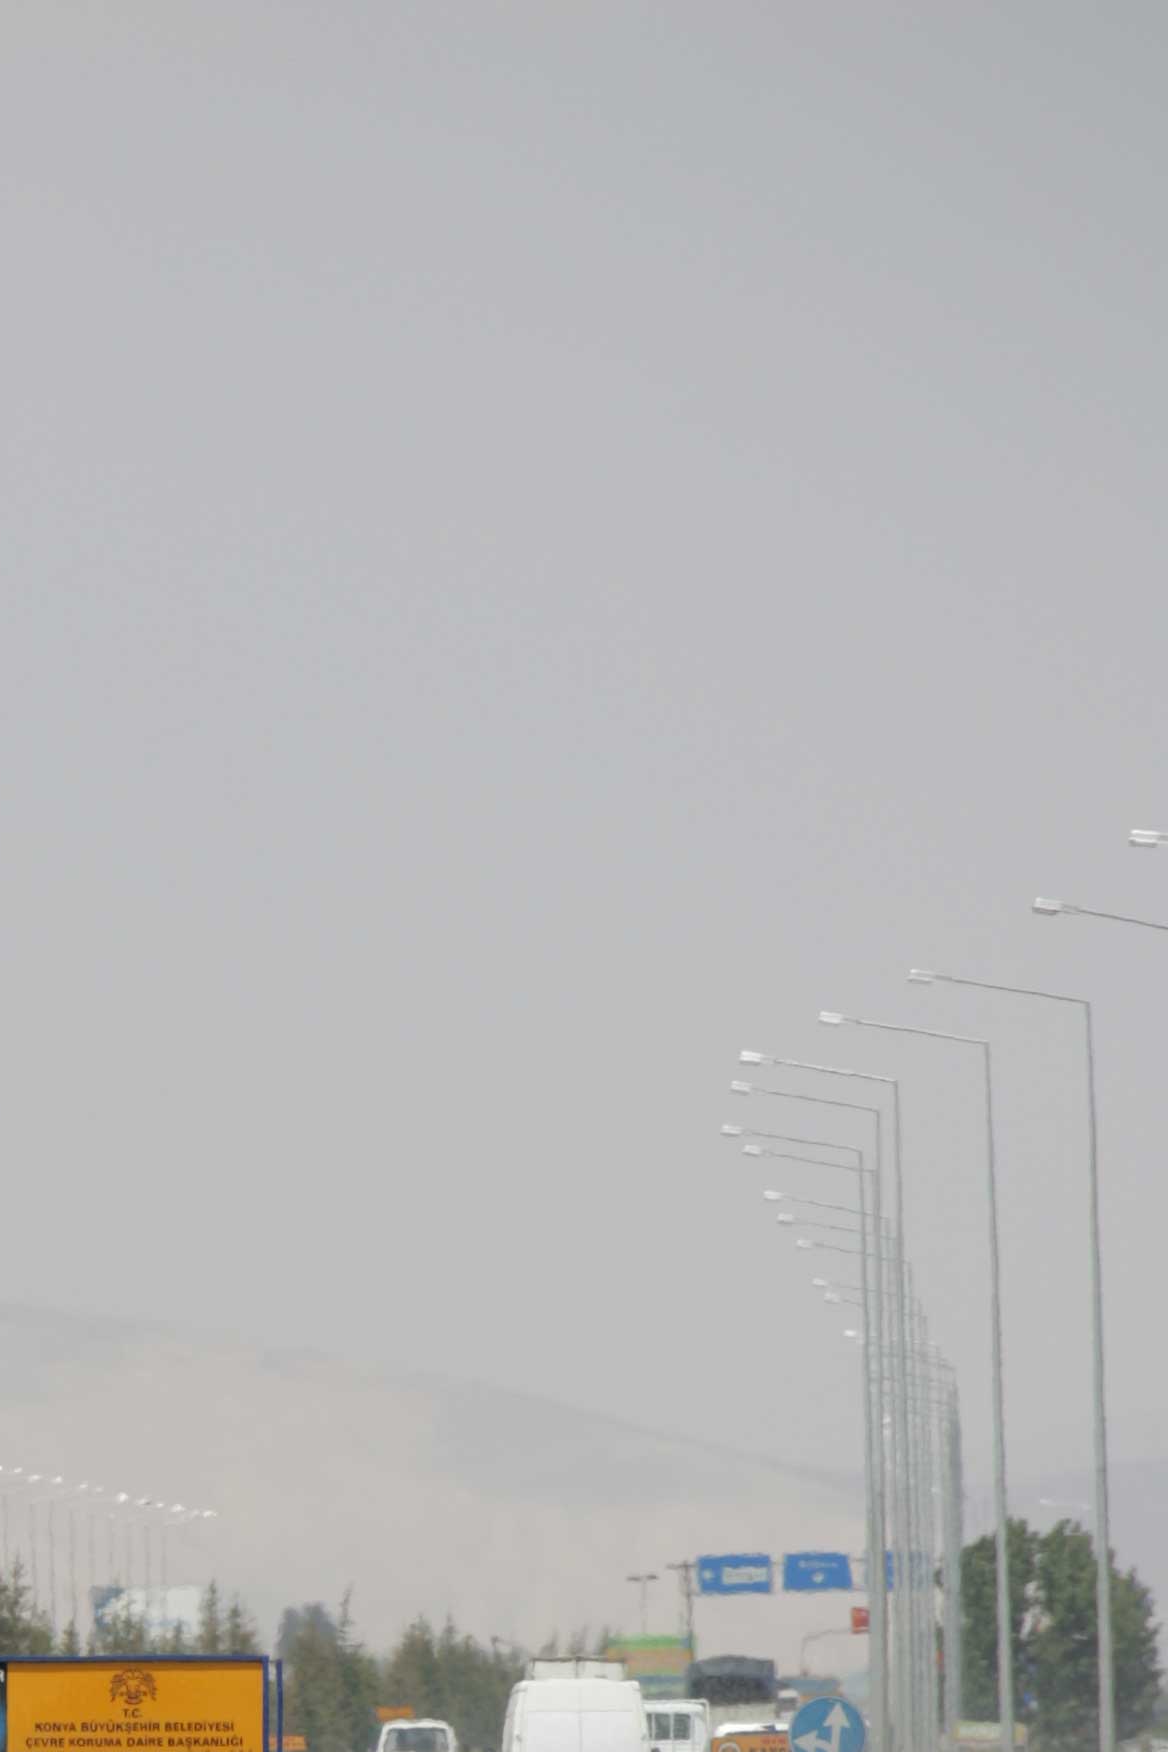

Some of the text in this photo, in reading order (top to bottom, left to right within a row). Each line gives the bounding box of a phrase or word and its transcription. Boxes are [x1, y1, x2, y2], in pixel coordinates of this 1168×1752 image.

[35, 1721, 76, 1732] KONYA
[80, 1719, 160, 1734] BÜYÜKŞEHİR
[25, 1735, 244, 1750] ÇEVRE KORUMA DAİRE BAŞKANLIĞI
